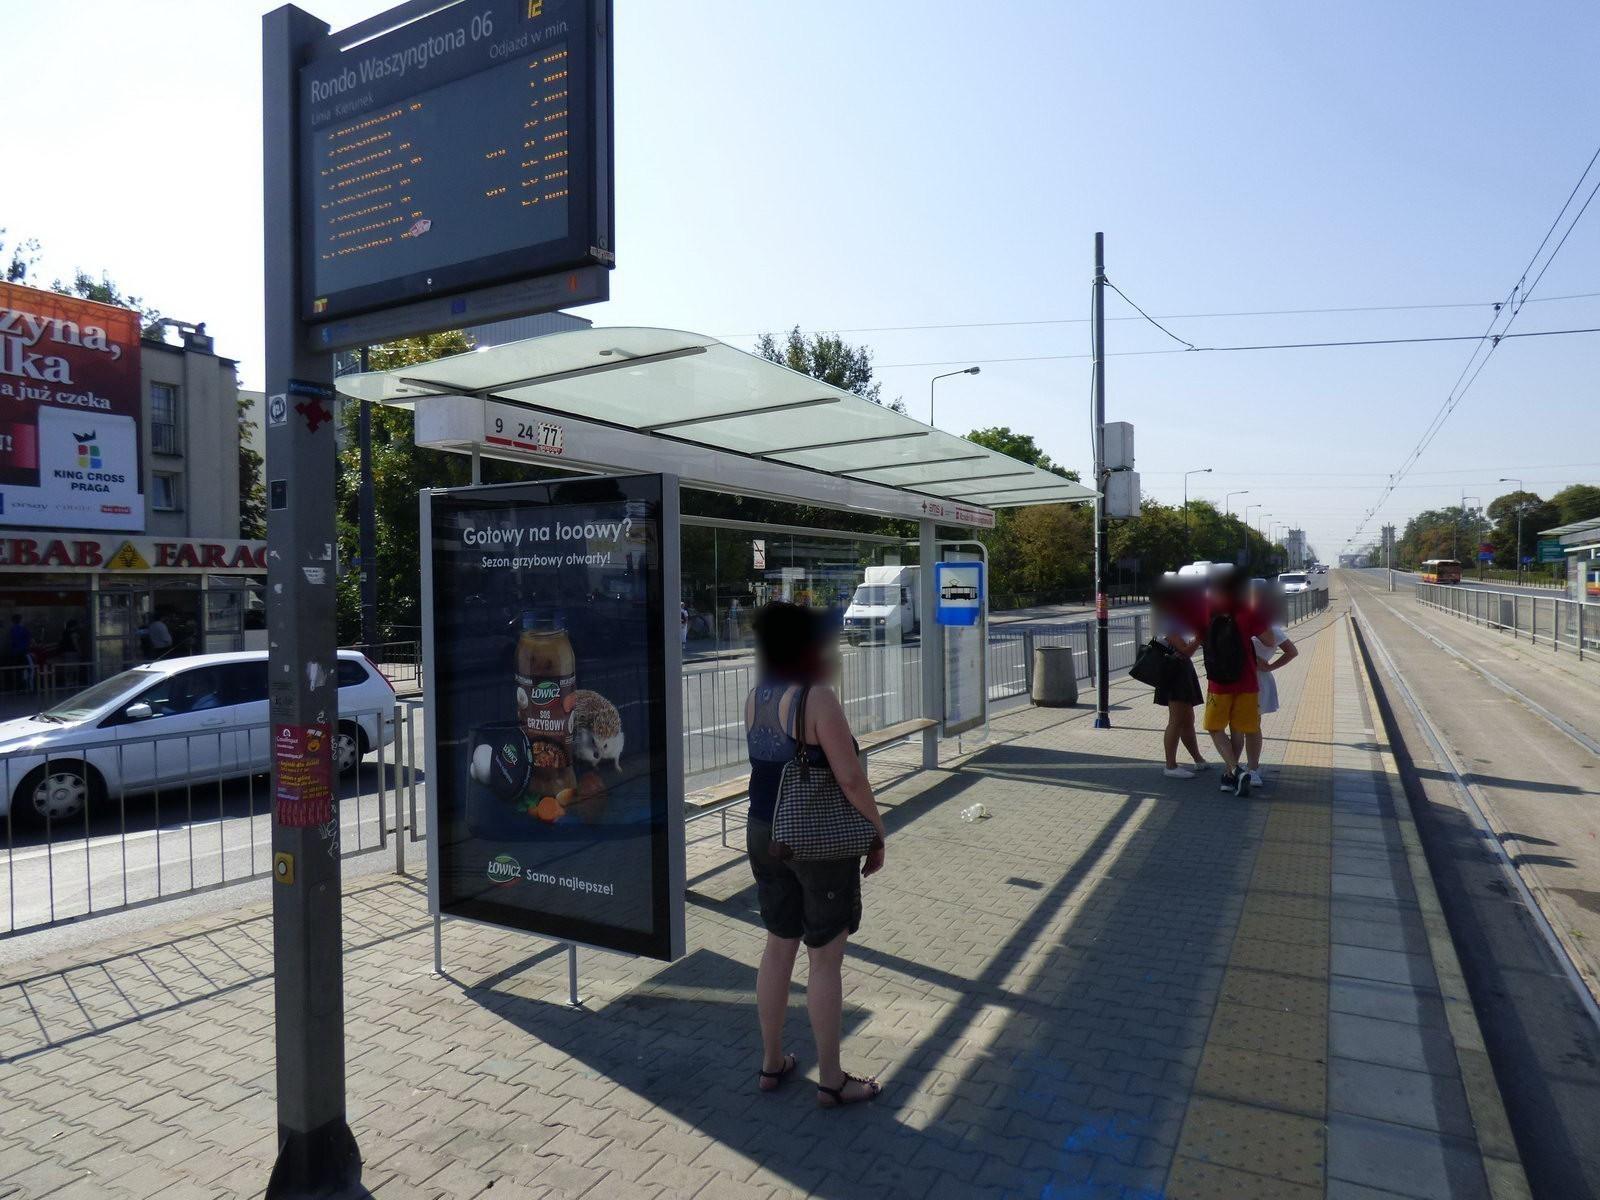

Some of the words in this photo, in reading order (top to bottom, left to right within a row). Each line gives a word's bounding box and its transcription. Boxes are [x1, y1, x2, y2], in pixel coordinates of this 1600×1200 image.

[311, 67, 357, 104] Rondo
[360, 28, 466, 77] Waszyngtona
[471, 10, 493, 41] 06
[489, 32, 528, 58] Odjazd
[531, 31, 542, 43] w
[16, 381, 52, 401] już
[56, 391, 112, 410] czeka
[495, 417, 504, 434] 9
[517, 422, 534, 440] 24
[543, 426, 558, 447] 77
[54, 469, 84, 480] KING
[87, 471, 125, 483] CROSS
[71, 482, 110, 493] PRAGA
[463, 525, 524, 547] Gotowy
[529, 527, 550, 542] na
[556, 517, 632, 543] łooowy?
[482, 556, 510, 569] Sezon
[512, 553, 563, 569] grzybowy
[566, 552, 611, 567] otwarty!
[527, 717, 566, 731] GRZYBOWY
[540, 710, 551, 719] SOS
[488, 861, 521, 878] ŁOWICZ
[526, 869, 556, 885] Samo
[559, 877, 614, 896] najlepsze!
